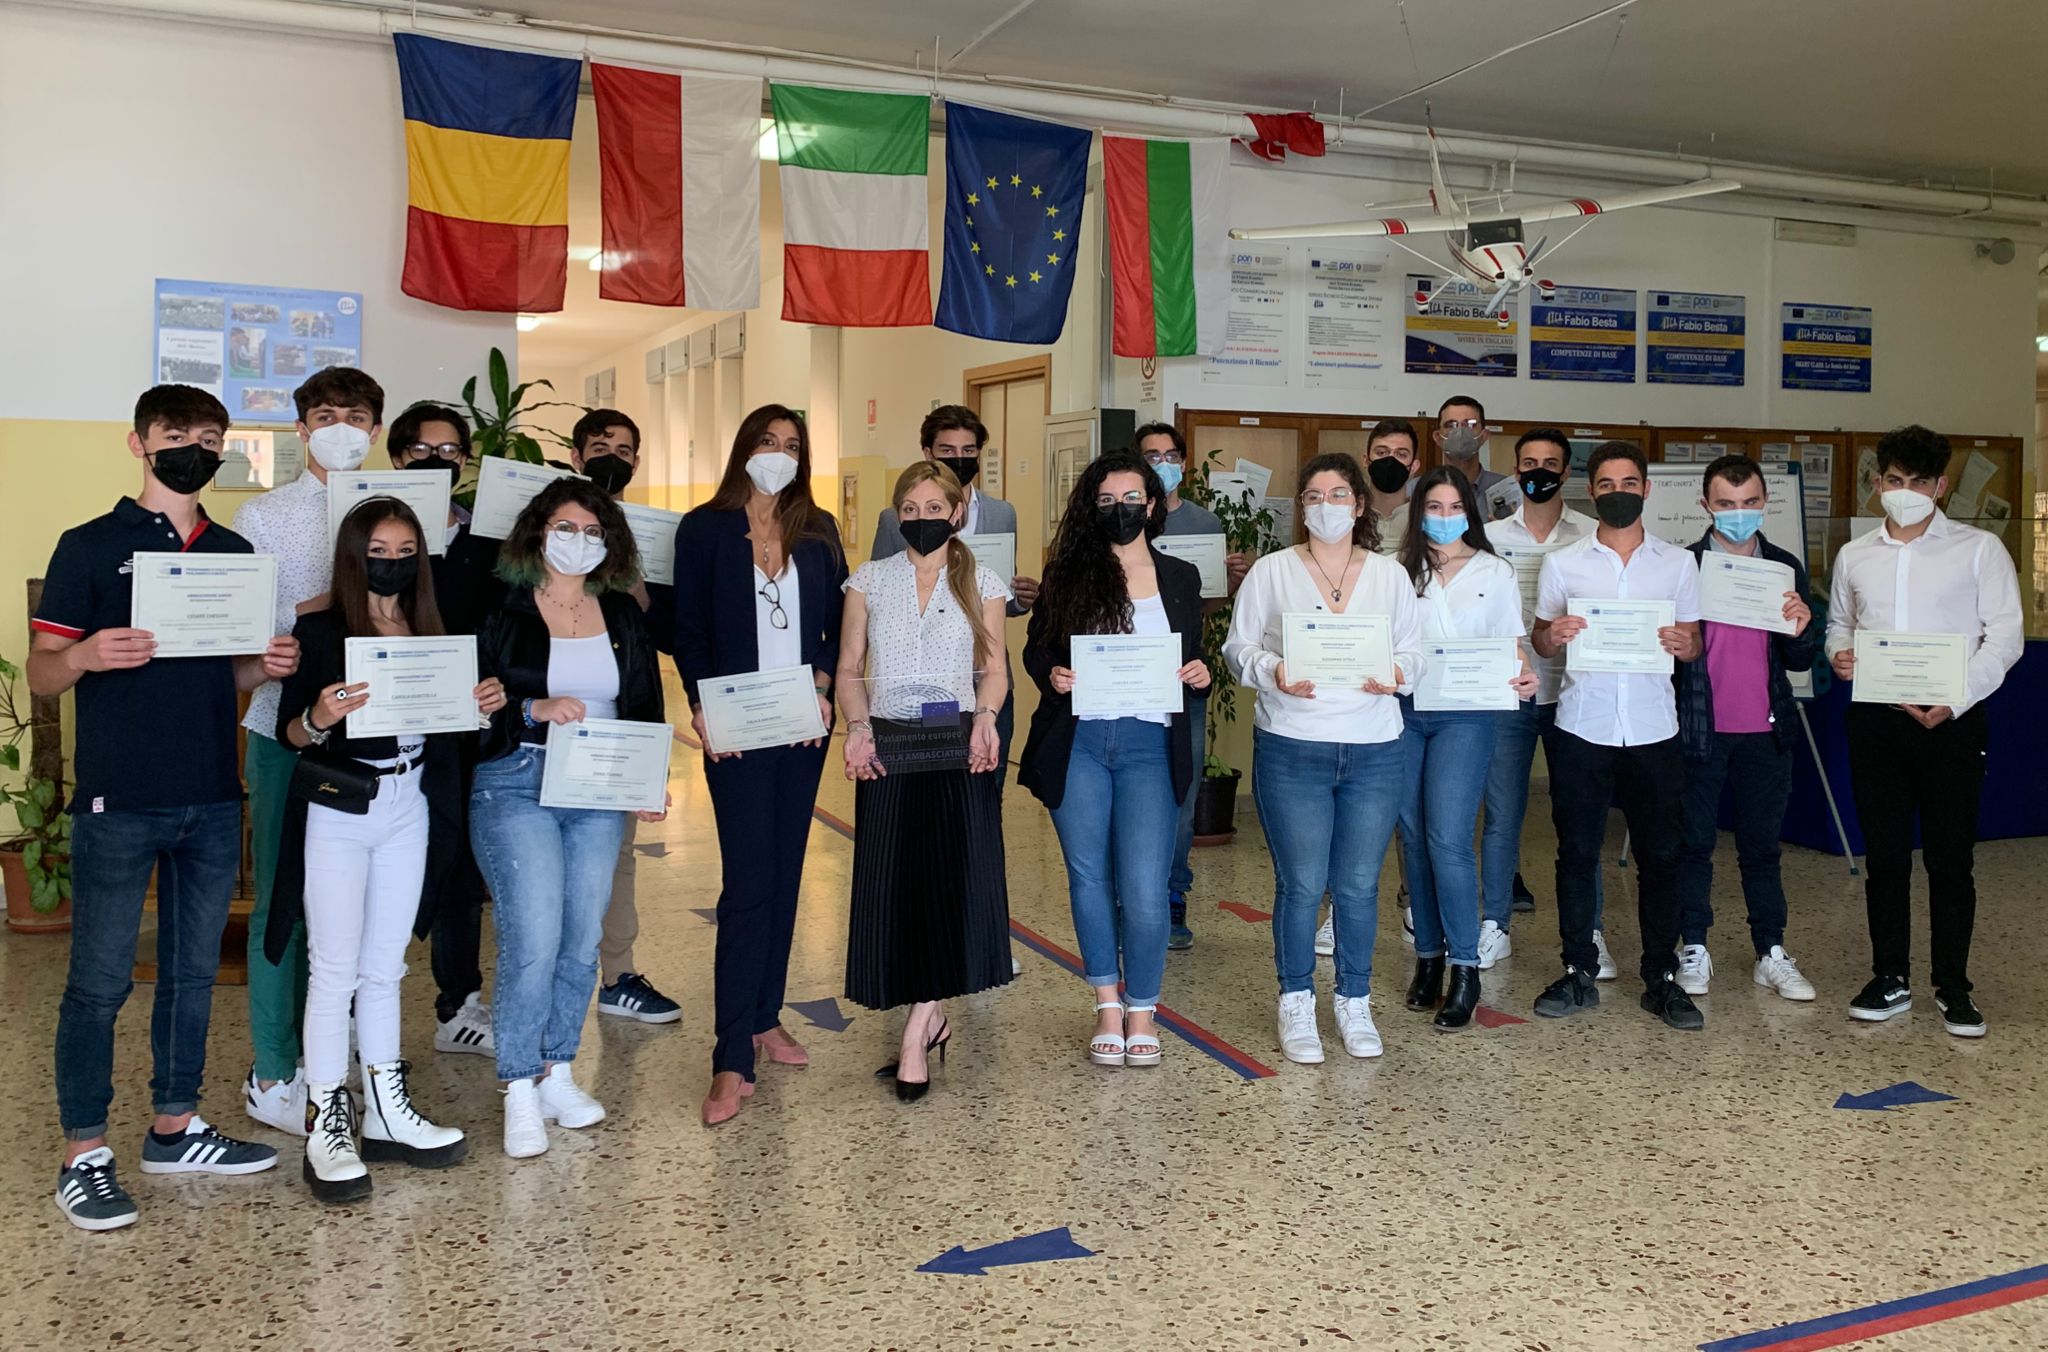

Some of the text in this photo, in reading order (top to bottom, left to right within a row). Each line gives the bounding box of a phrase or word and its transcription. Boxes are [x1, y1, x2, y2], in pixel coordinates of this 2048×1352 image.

[1580, 291, 1600, 304] pon
[1693, 297, 1711, 309] pon
[1443, 306, 1470, 318] Fabio
[1564, 315, 1590, 327] Fabio
[1592, 317, 1618, 328] Besta
[1679, 320, 1702, 331] Fabio
[1704, 321, 1728, 333] Besta
[1485, 337, 1513, 345] ENGLAND
[1812, 331, 1834, 341] Fabio
[1835, 333, 1856, 342] Besta
[1551, 349, 1617, 359] COMPETENZE DI BASE
[878, 731, 962, 744] Parlamento europeo
